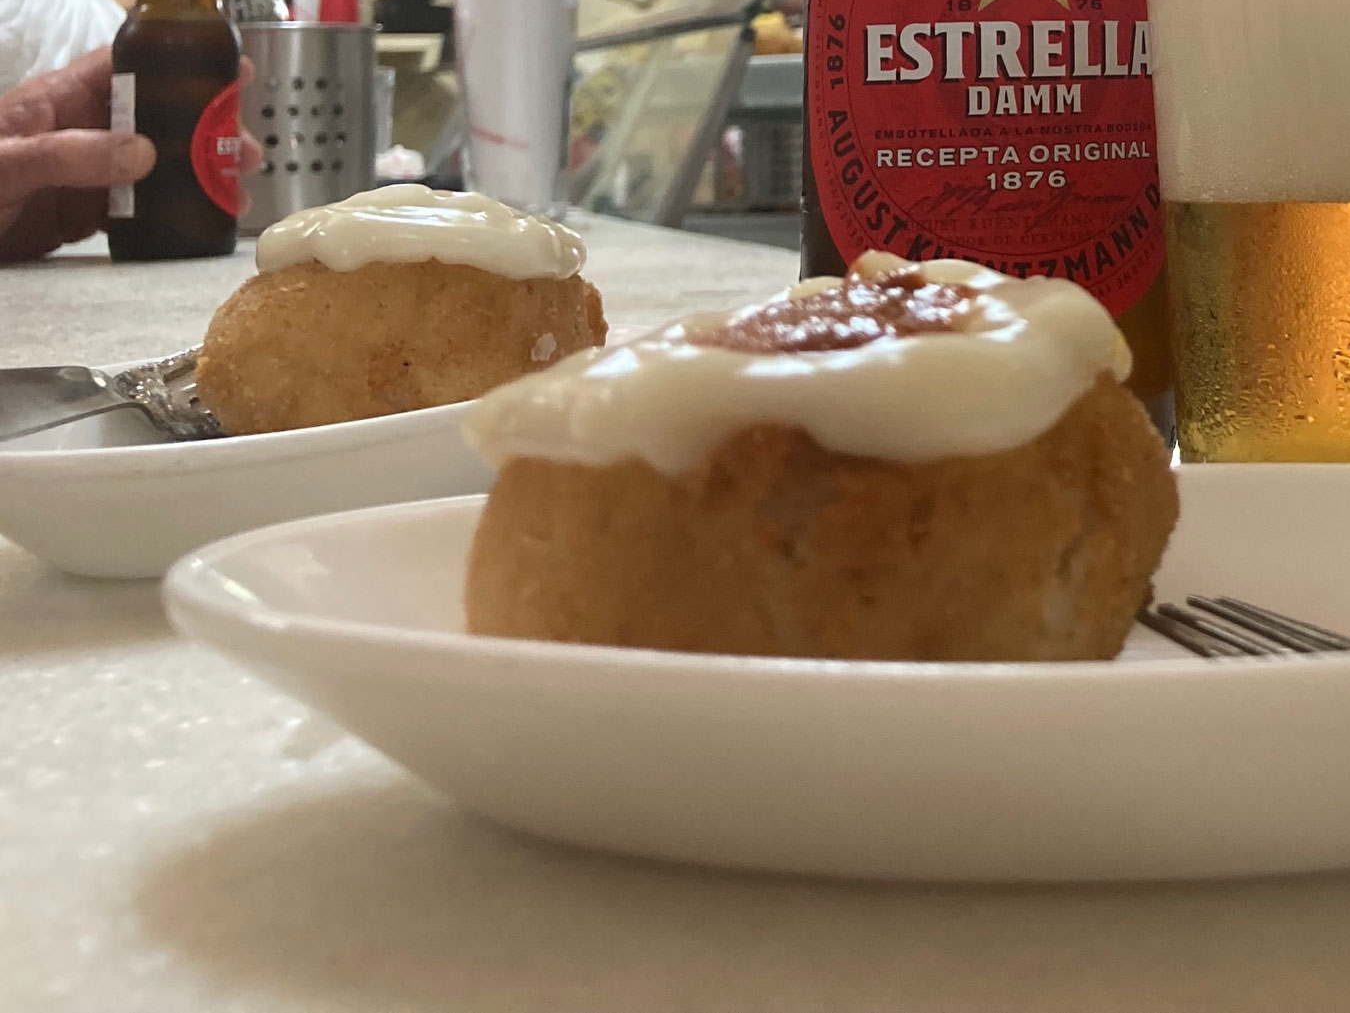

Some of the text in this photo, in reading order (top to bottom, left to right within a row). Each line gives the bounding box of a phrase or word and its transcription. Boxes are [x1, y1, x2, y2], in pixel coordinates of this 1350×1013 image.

[946, 0, 972, 12] 18
[826, 13, 847, 90] 1876
[863, 20, 1152, 85] ESTRELLA
[967, 83, 1084, 117] DAMM
[874, 126, 993, 141] EMBOTELLADA
[999, 127, 1009, 138] A
[1014, 126, 1035, 137] LA
[1040, 123, 1101, 136] NOSTRA
[876, 140, 1151, 169] RECEPTA ORIGINAL
[827, 109, 909, 246] AUGUST
[986, 169, 1067, 191] 1876
